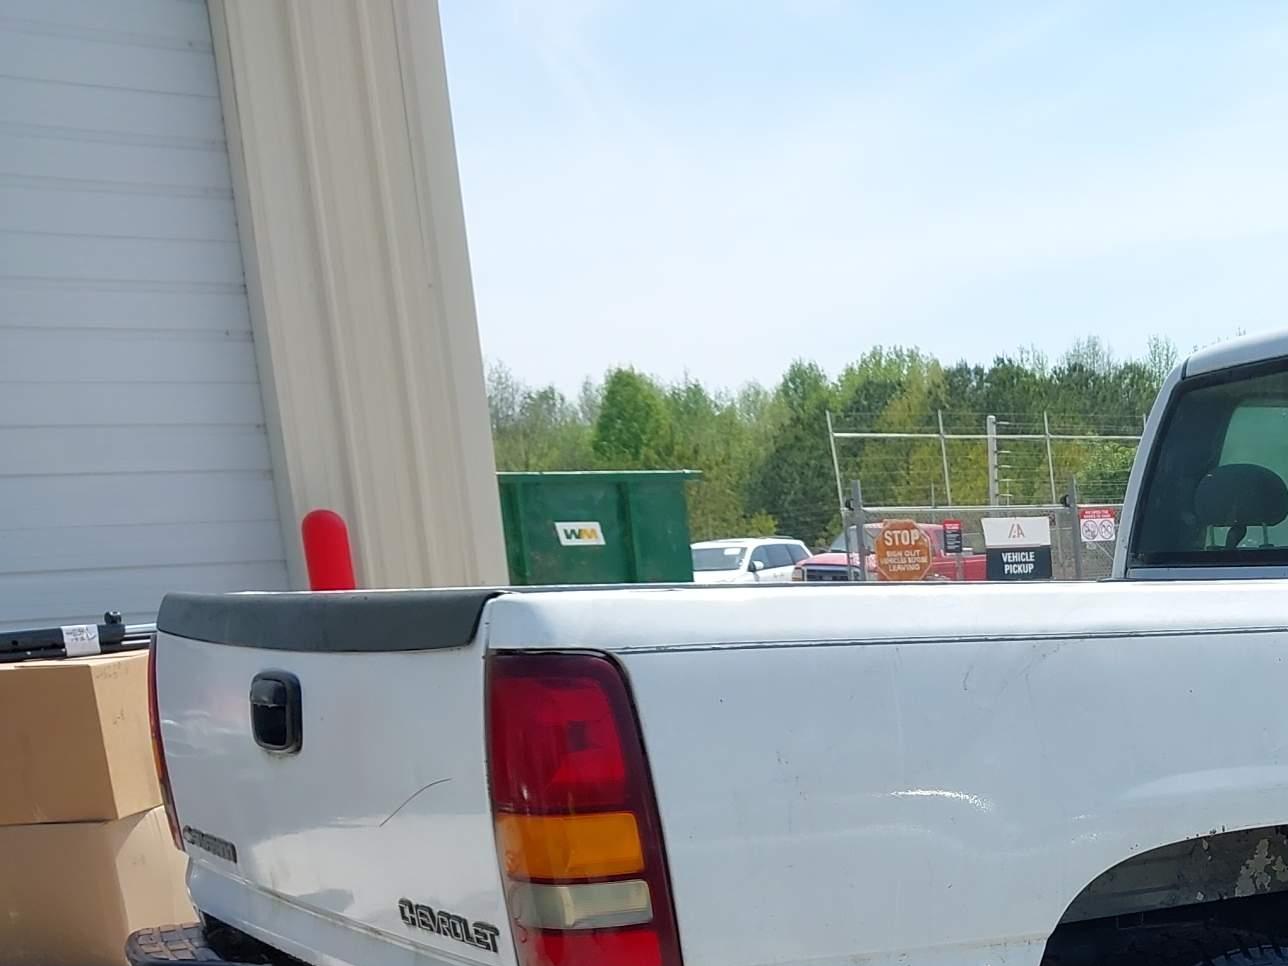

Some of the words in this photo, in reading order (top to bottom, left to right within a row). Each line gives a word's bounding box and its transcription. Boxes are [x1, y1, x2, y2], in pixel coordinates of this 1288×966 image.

[563, 527, 599, 541] WM
[884, 529, 920, 546] STOP
[904, 549, 921, 557] OUT
[1002, 551, 1035, 563] VEHICLE
[1004, 563, 1035, 575] PICKUP
[398, 897, 500, 954] CHEVROLET
